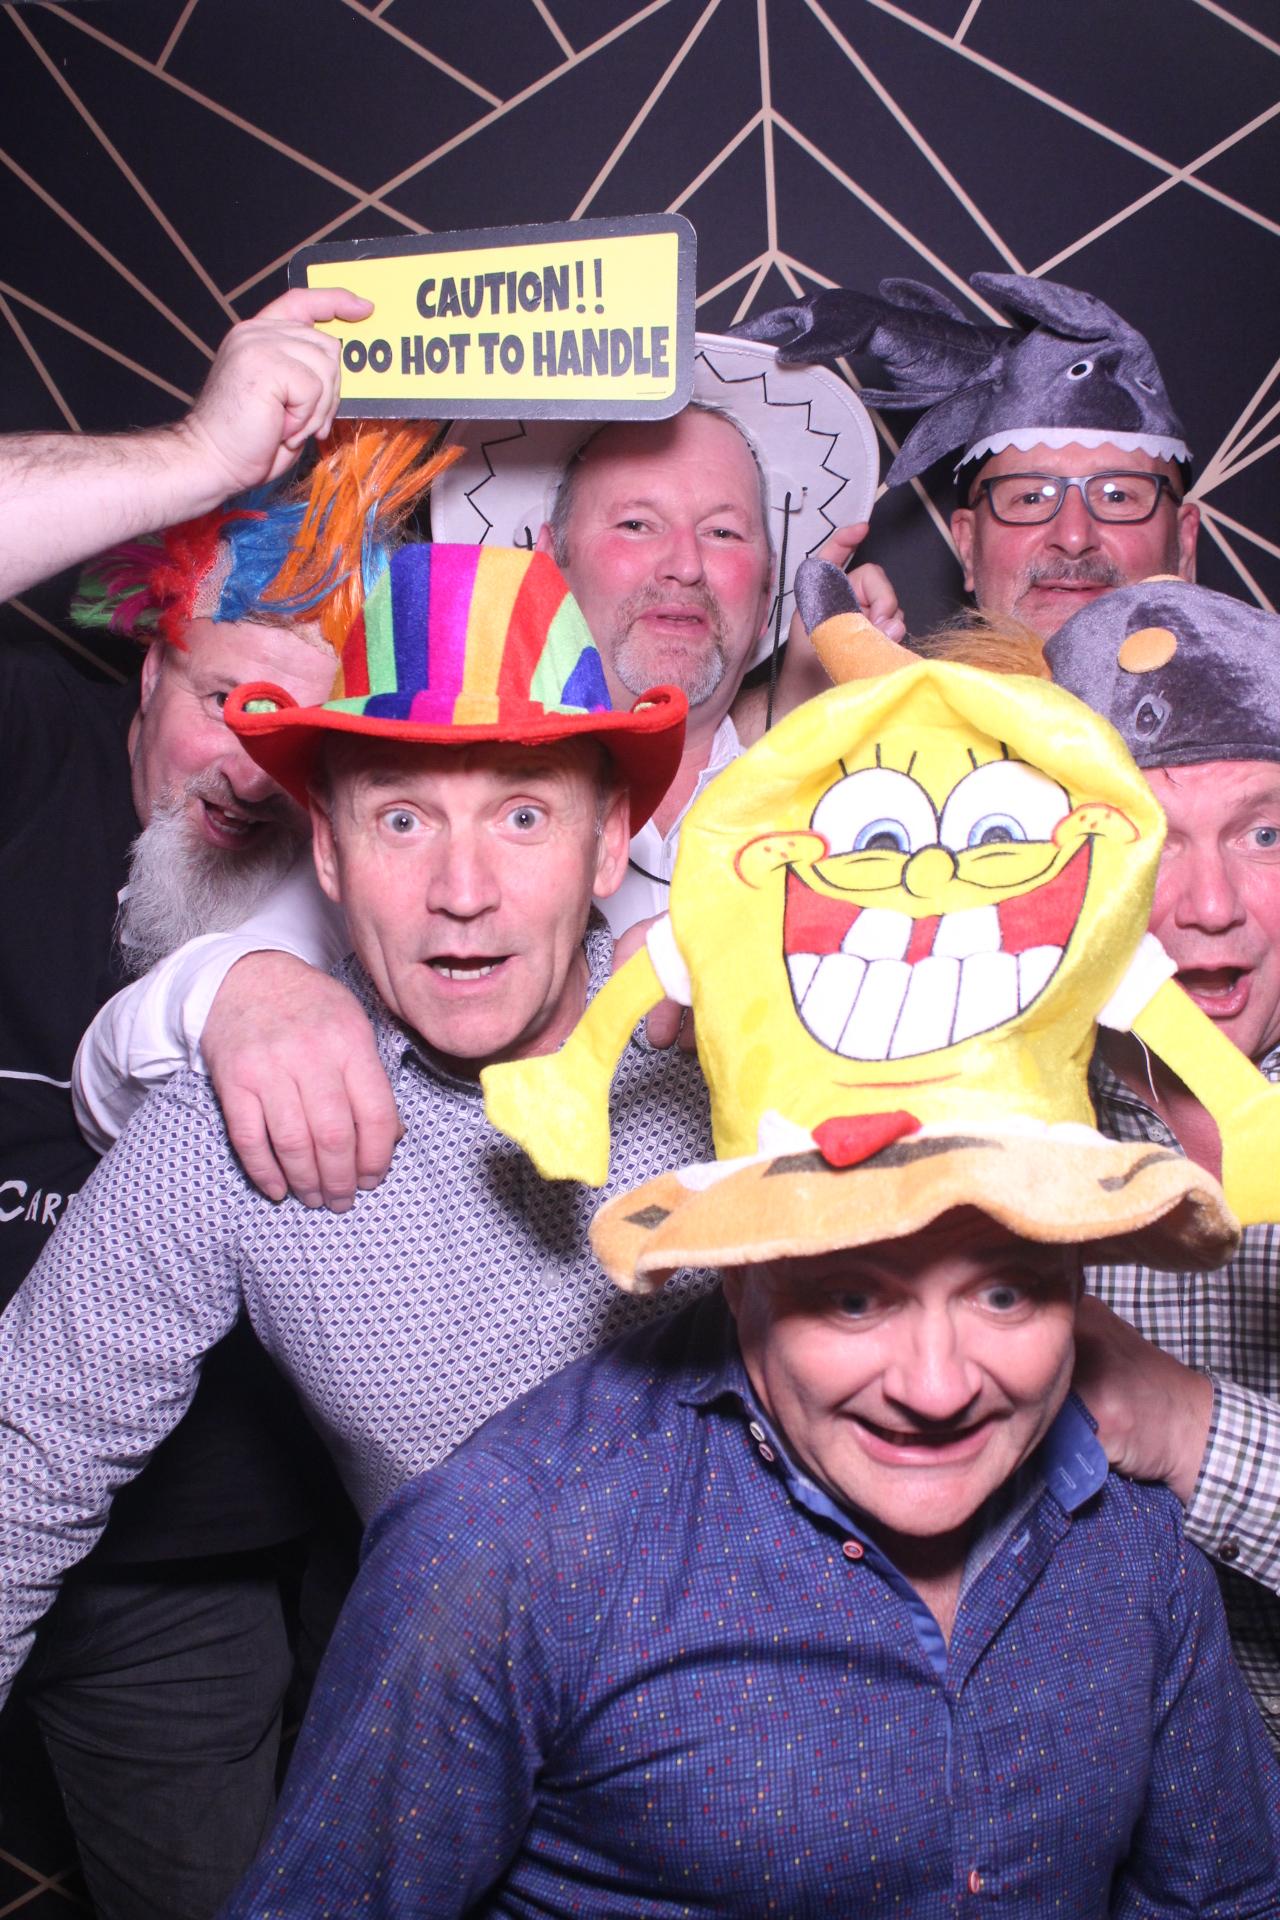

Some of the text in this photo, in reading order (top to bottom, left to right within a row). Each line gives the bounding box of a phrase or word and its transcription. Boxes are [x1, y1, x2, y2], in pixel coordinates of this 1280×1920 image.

[416, 258, 604, 319] CAUTION!!
[339, 326, 670, 378] OO HOT TO HANDLE
[0, 1180, 79, 1225] CAR
